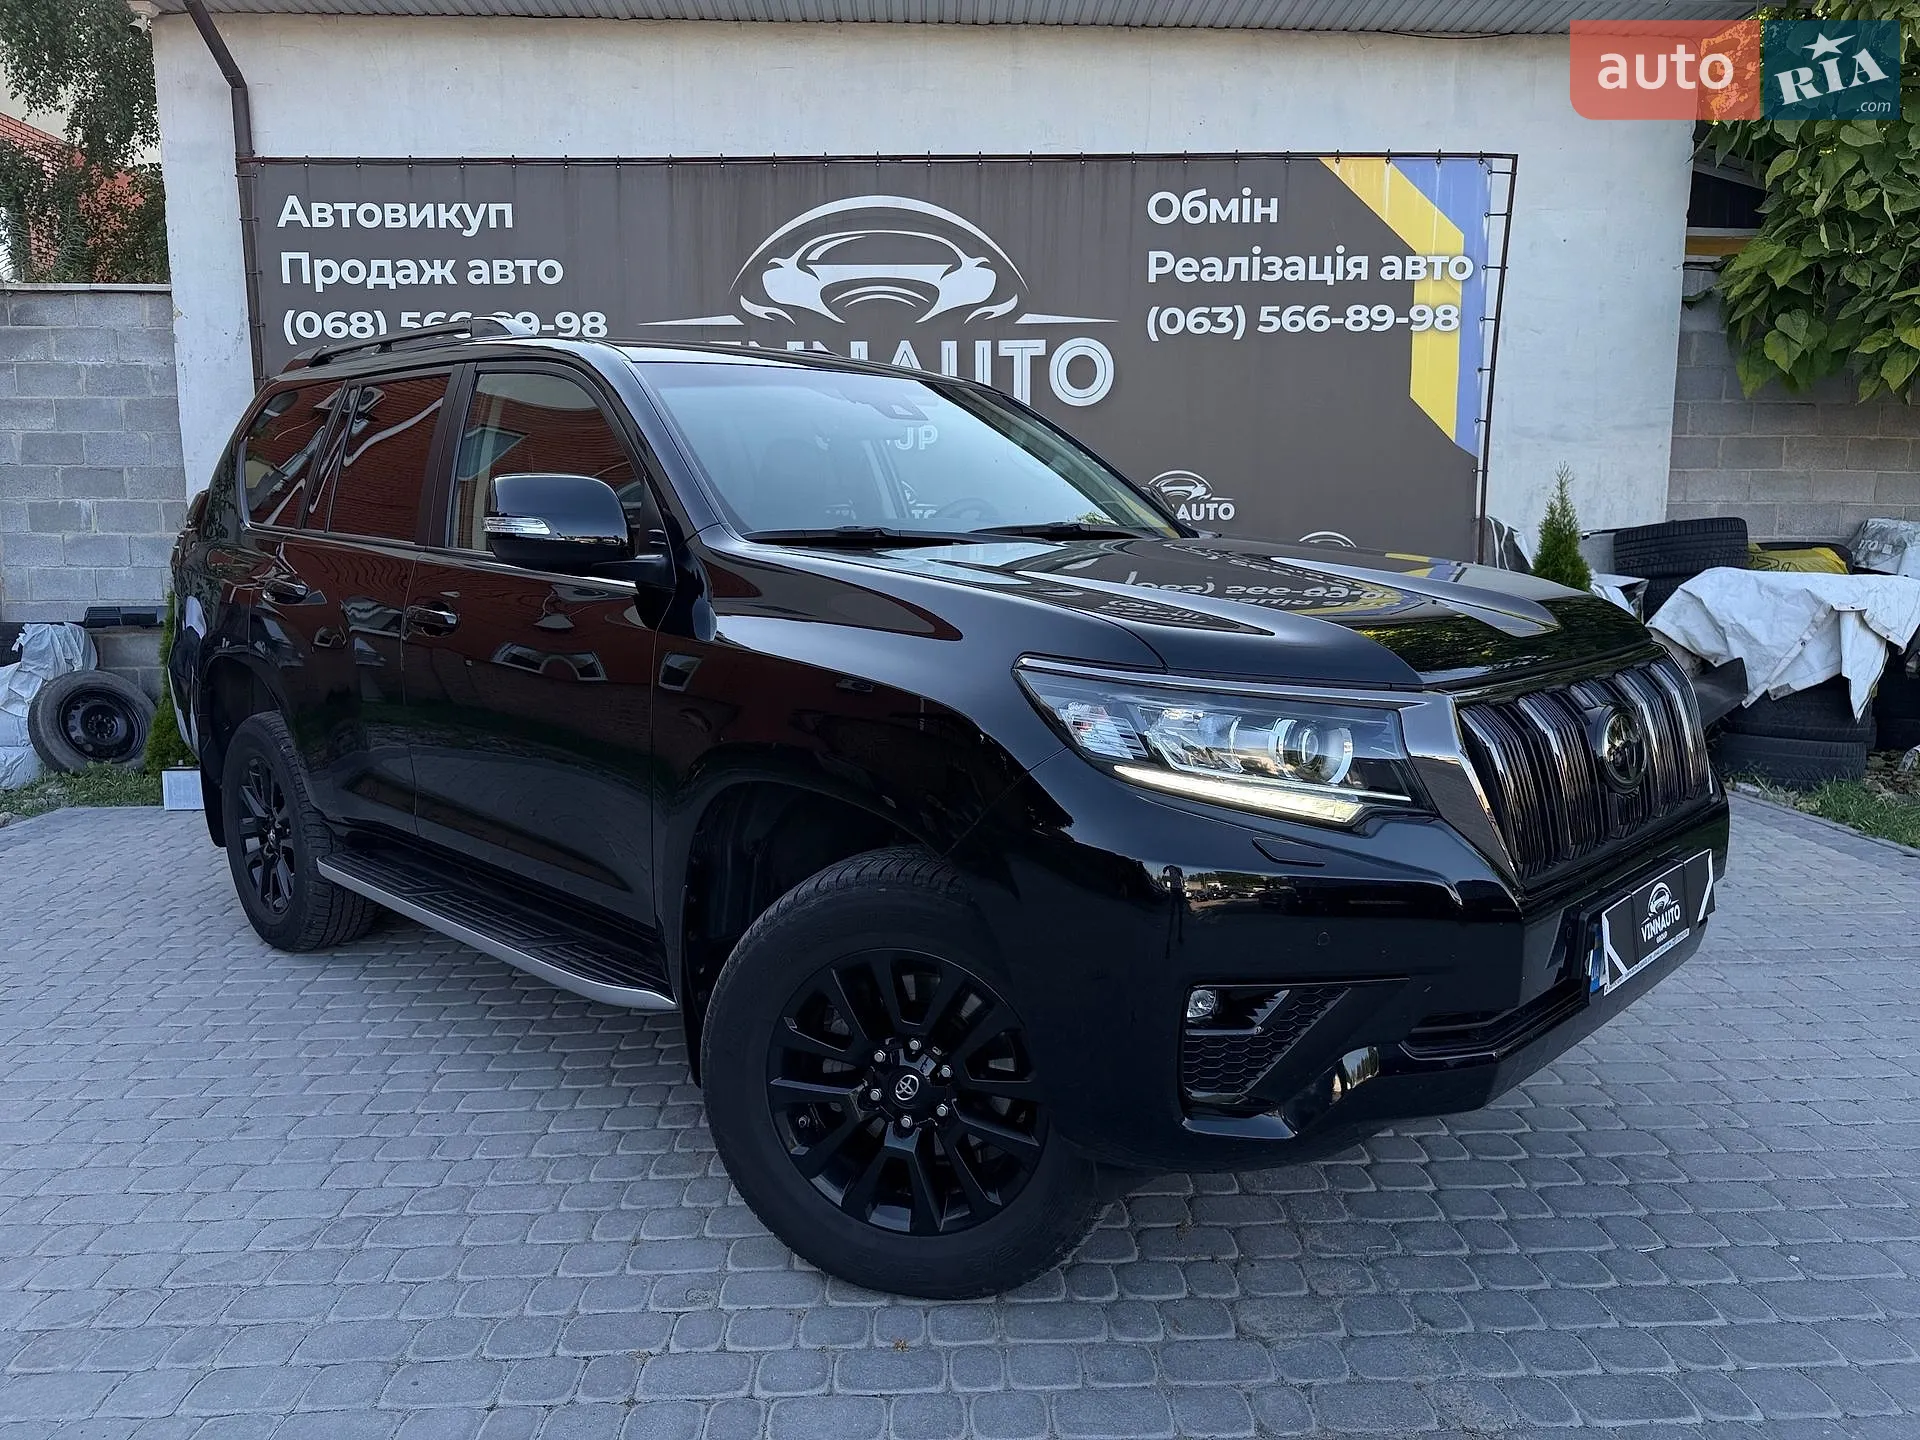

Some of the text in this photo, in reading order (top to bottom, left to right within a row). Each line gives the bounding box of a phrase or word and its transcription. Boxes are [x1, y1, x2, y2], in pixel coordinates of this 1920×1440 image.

[276, 195, 513, 237] Автовикуп
[1147, 187, 1278, 225] Обмін
[280, 252, 564, 293] Продаж авто
[1147, 244, 1474, 286] Реалізація авто
[282, 309, 388, 345] (068)
[1146, 304, 1460, 342] (063) 566-89-98
[1641, 904, 1681, 942] VINNAUTO
